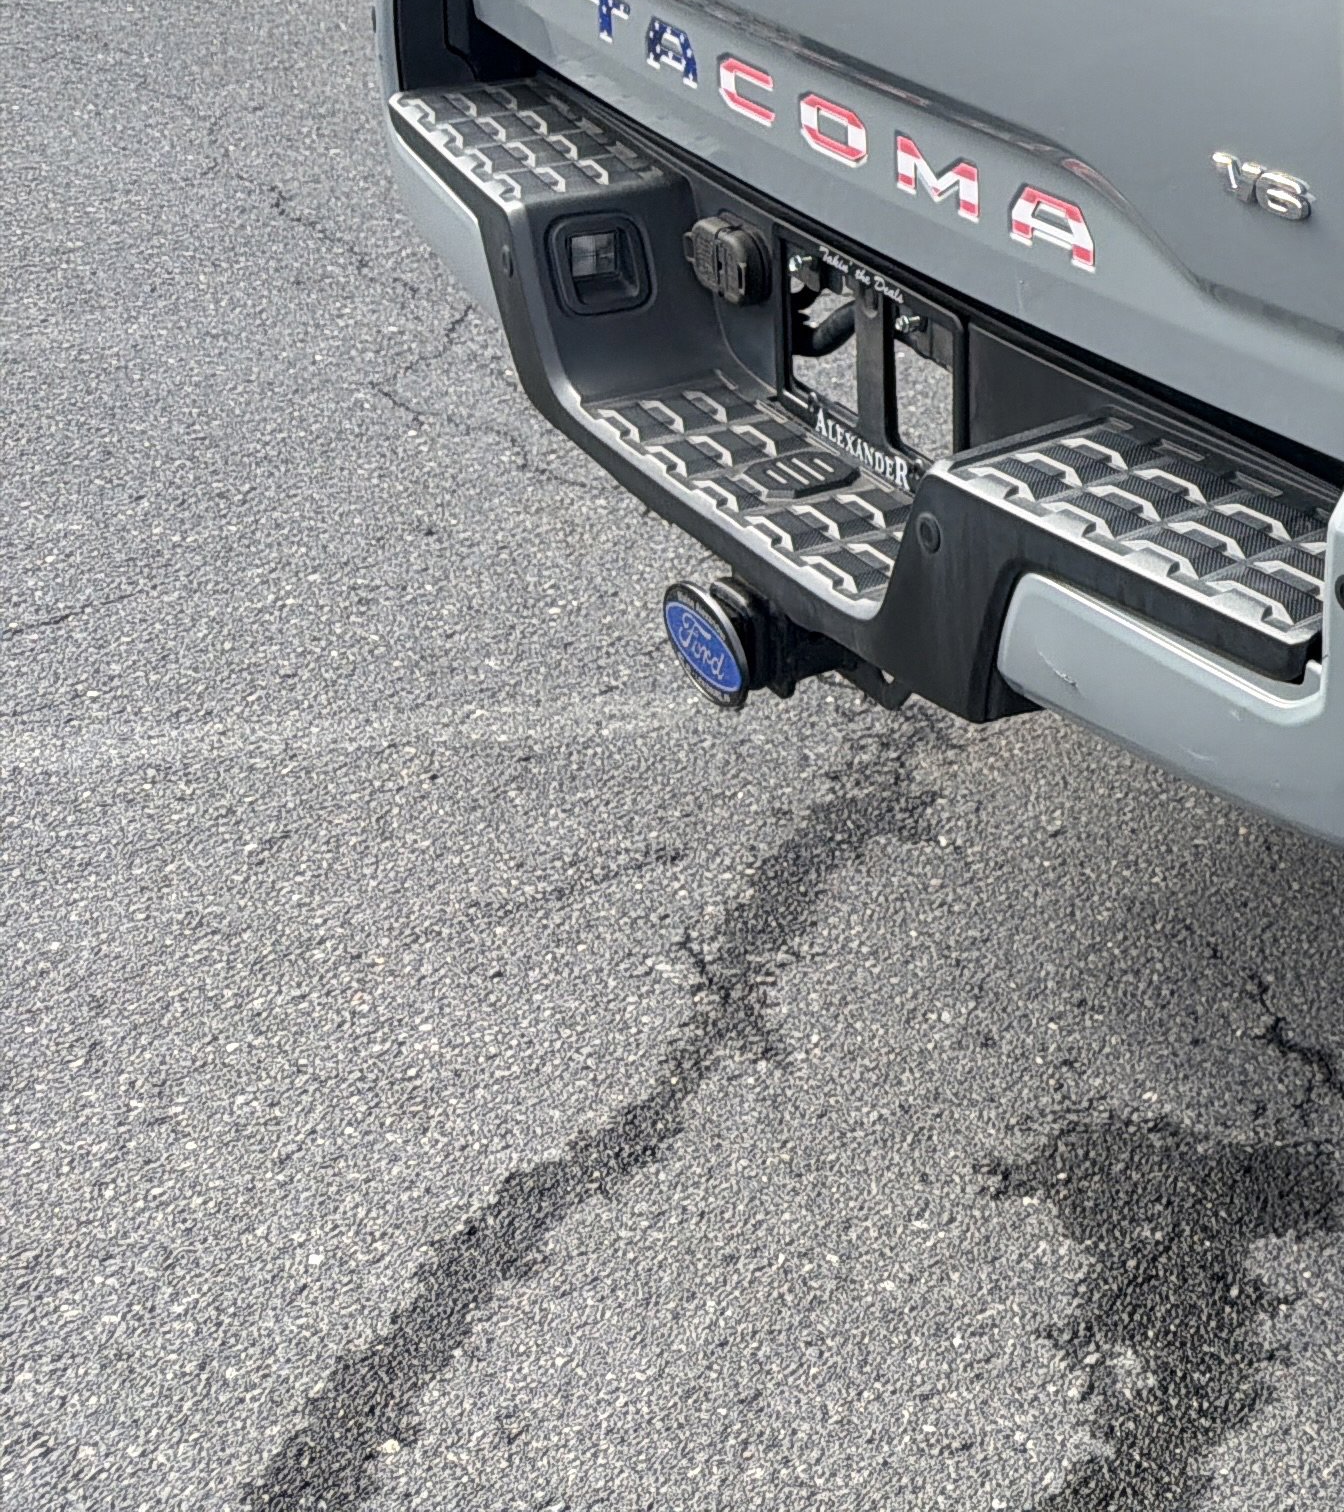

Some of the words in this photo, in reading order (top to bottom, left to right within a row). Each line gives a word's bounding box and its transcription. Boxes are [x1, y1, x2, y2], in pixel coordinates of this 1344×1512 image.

[1212, 152, 1316, 220] V6
[855, 269, 870, 285] the
[874, 276, 904, 304] Deals
[815, 407, 910, 491] ALEXANDER
[679, 612, 724, 680] Ford
